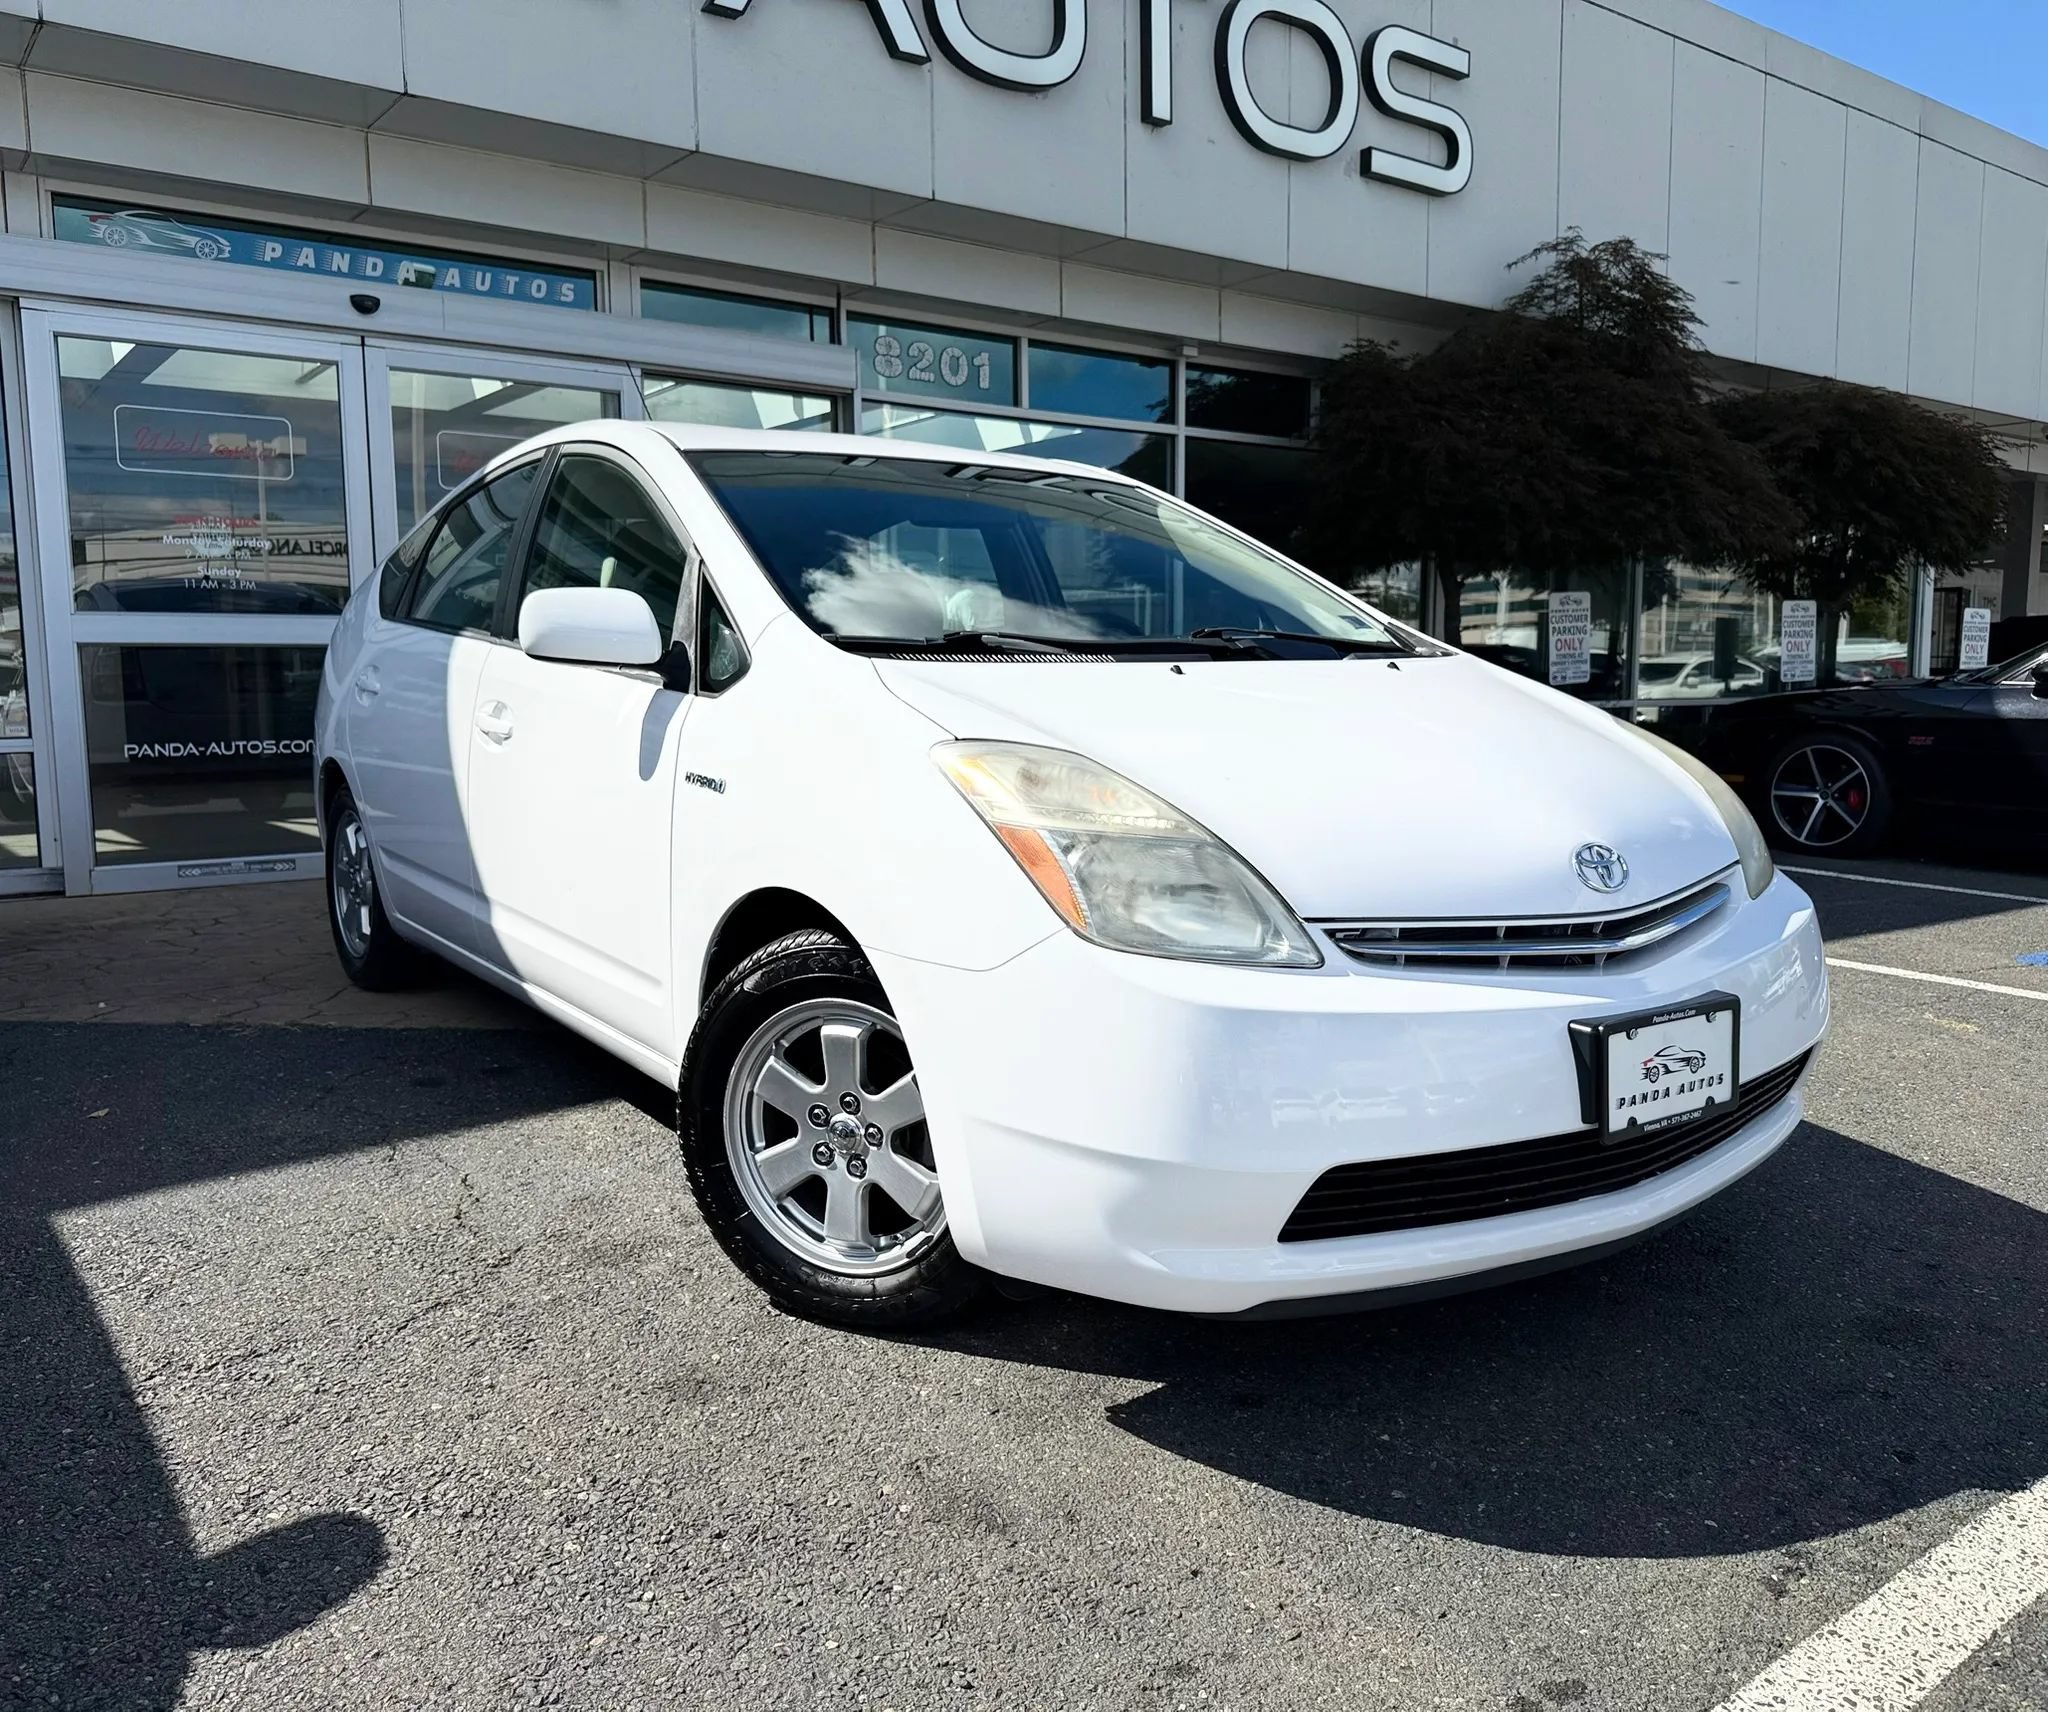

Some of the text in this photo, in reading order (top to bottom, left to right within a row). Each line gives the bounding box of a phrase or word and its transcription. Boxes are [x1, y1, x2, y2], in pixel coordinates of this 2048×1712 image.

[700, 0, 1474, 197] UTOS
[263, 240, 575, 302] PANDA AUTOS
[873, 335, 990, 389] 8201
[235, 550, 252, 560] PM
[197, 566, 241, 578] Sunday
[184, 579, 196, 588] 11
[200, 579, 219, 590] AM
[231, 579, 237, 590] 3
[240, 580, 257, 591] PM
[1550, 614, 1588, 625] CUSTOMER
[1783, 620, 1815, 629] CUSTOMER
[1551, 625, 1588, 636] PARKING
[1783, 630, 1814, 639] PARKING
[1963, 634, 1987, 643] PARKING
[1555, 638, 1584, 652] ONLY
[1786, 640, 1811, 653] ONLY
[1964, 643, 1985, 655] ONLY
[1617, 1073, 1725, 1110] PANDA AUTOS
